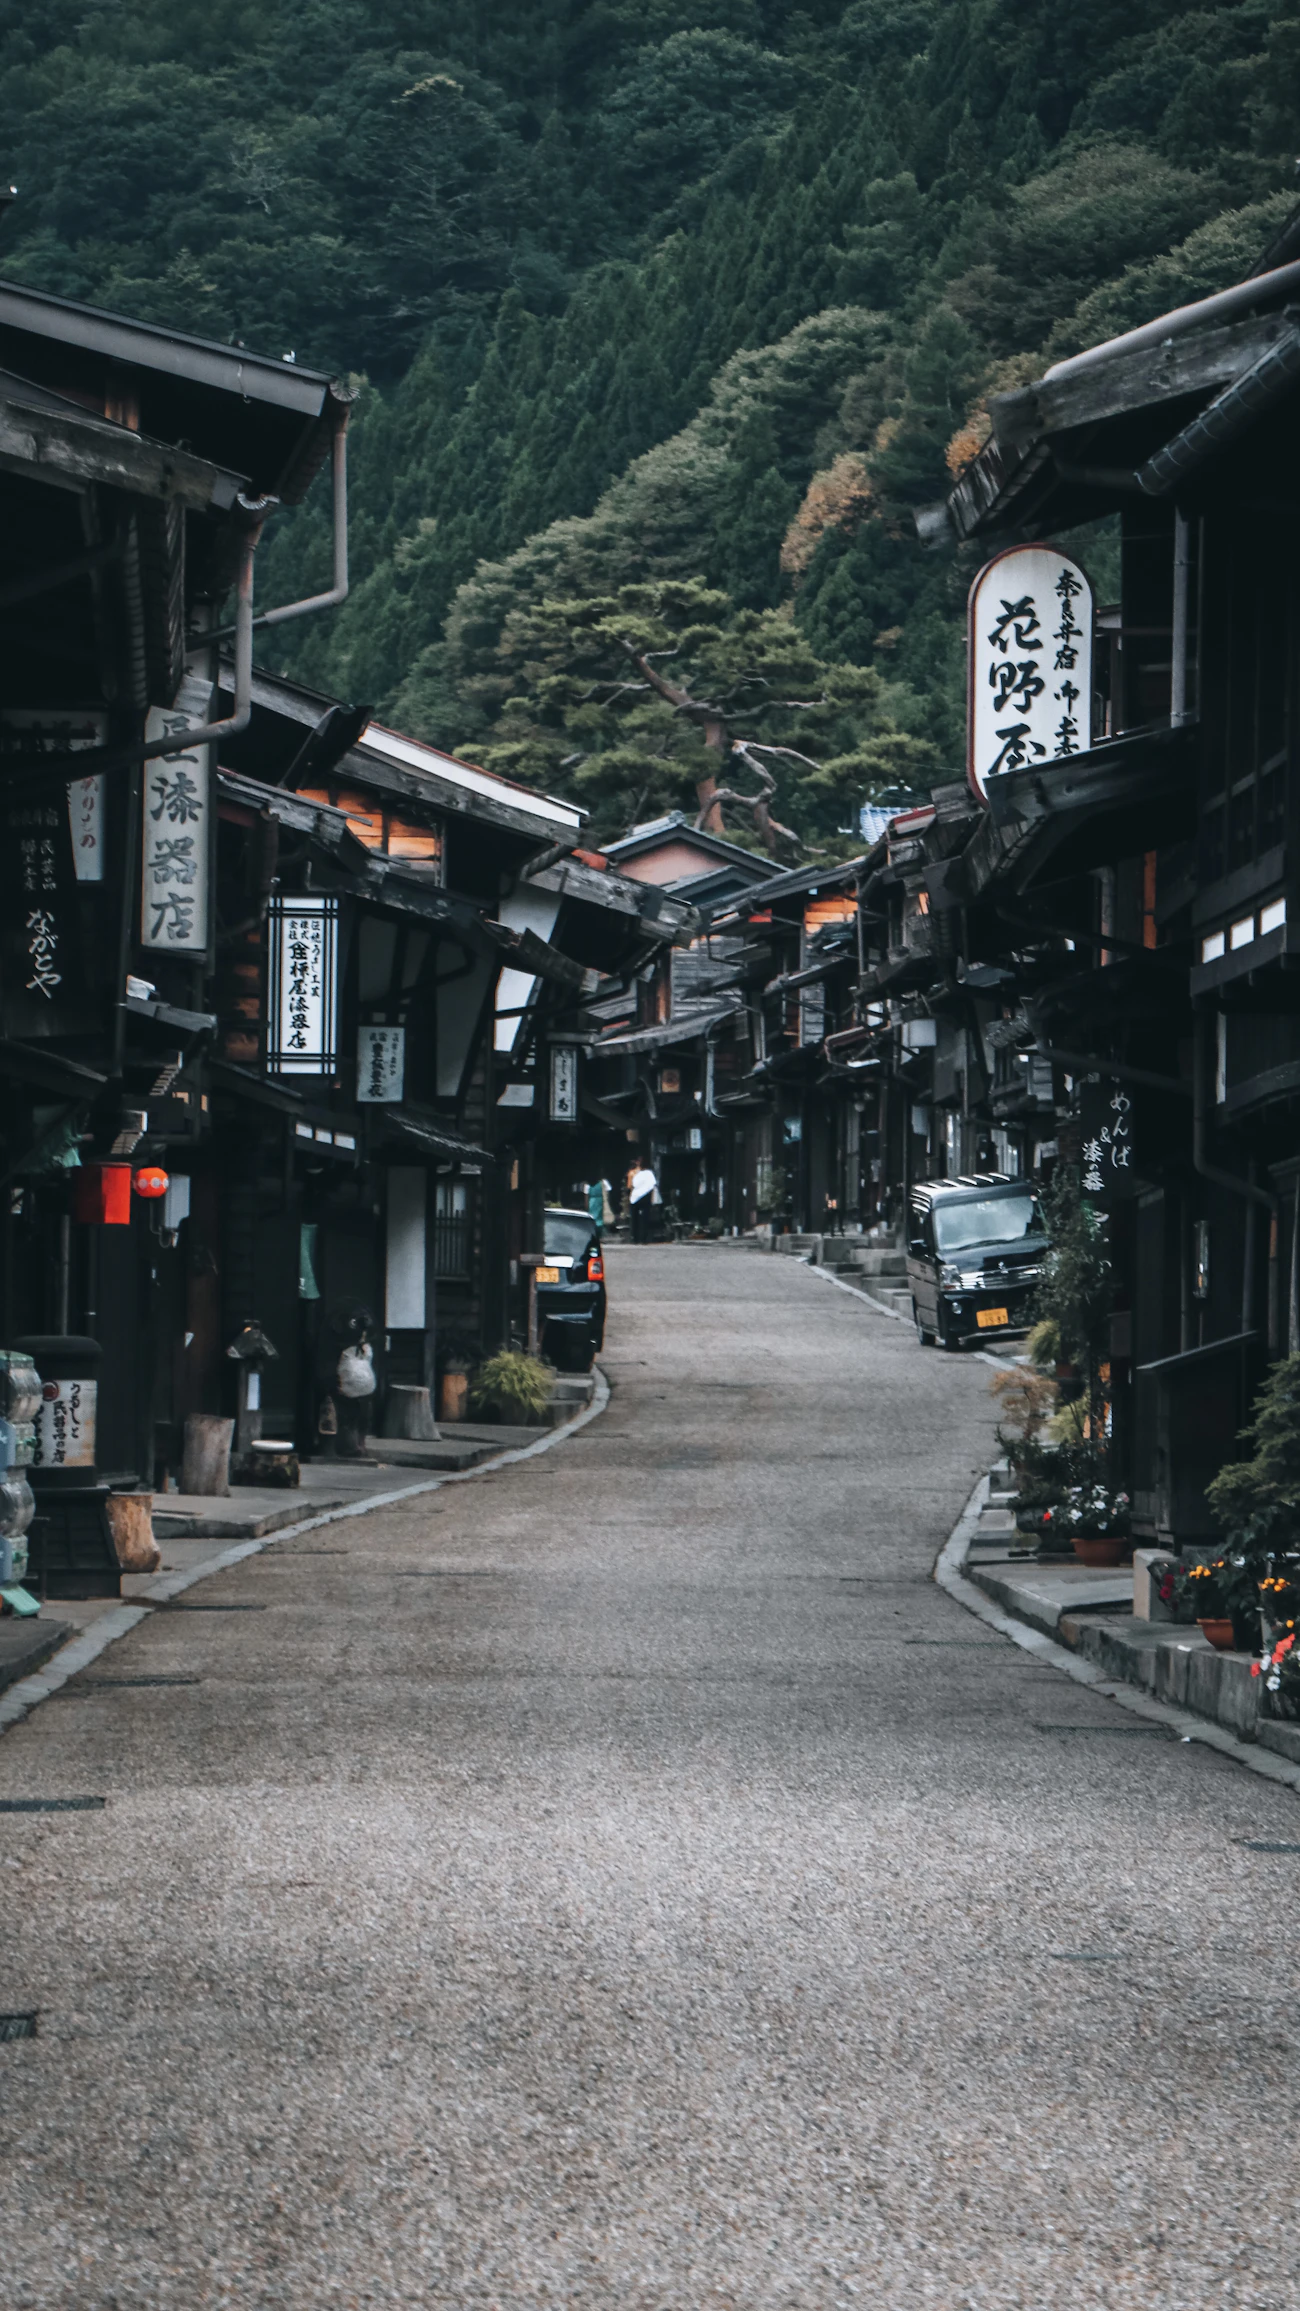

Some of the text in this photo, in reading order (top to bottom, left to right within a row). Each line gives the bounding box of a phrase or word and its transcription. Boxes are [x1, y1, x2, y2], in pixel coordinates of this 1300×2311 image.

[1052, 569, 1084, 671] 奈良井宿
[986, 595, 1047, 776] 花野屋
[25, 907, 63, 1000] ながとや
[1099, 1126, 1112, 1144] &
[1109, 1090, 1132, 1169] めんば
